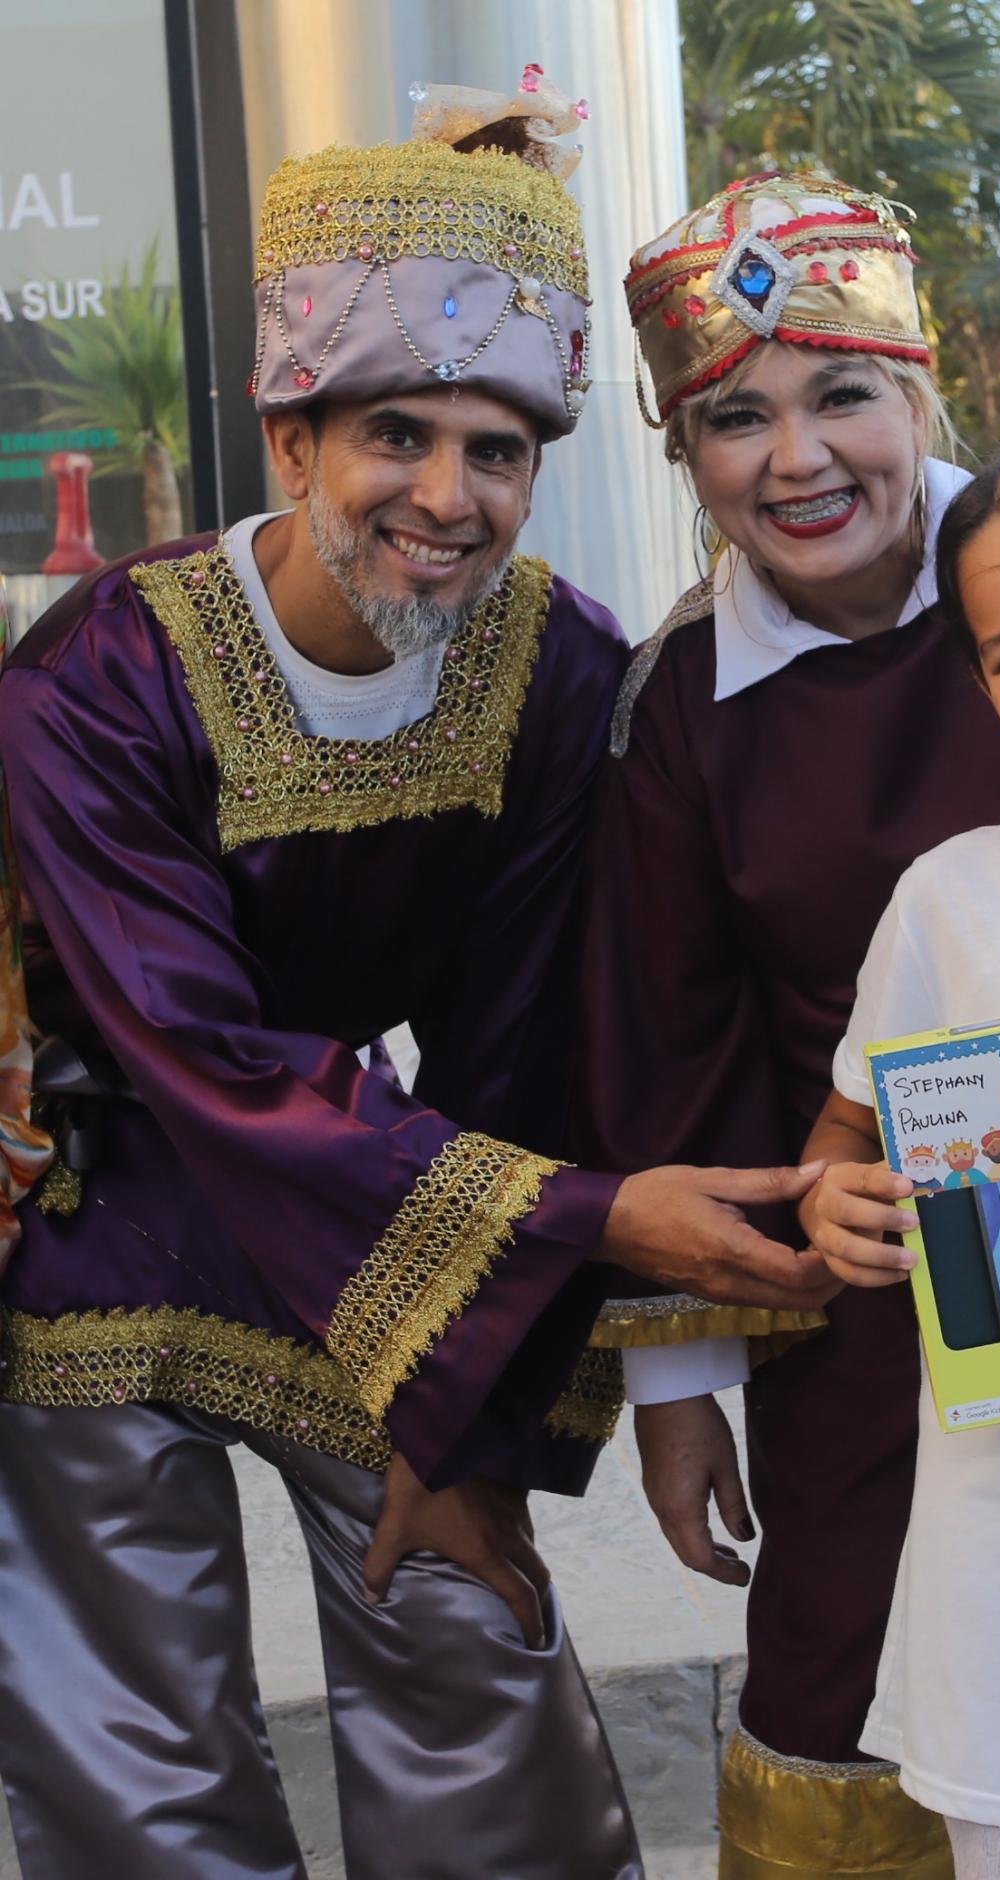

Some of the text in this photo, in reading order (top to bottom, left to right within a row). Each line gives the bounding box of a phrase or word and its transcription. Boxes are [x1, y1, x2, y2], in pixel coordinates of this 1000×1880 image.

[22, 278, 106, 322] SUR
[893, 1073, 985, 1099] STEPHANY
[897, 1107, 968, 1135] PAULINA
